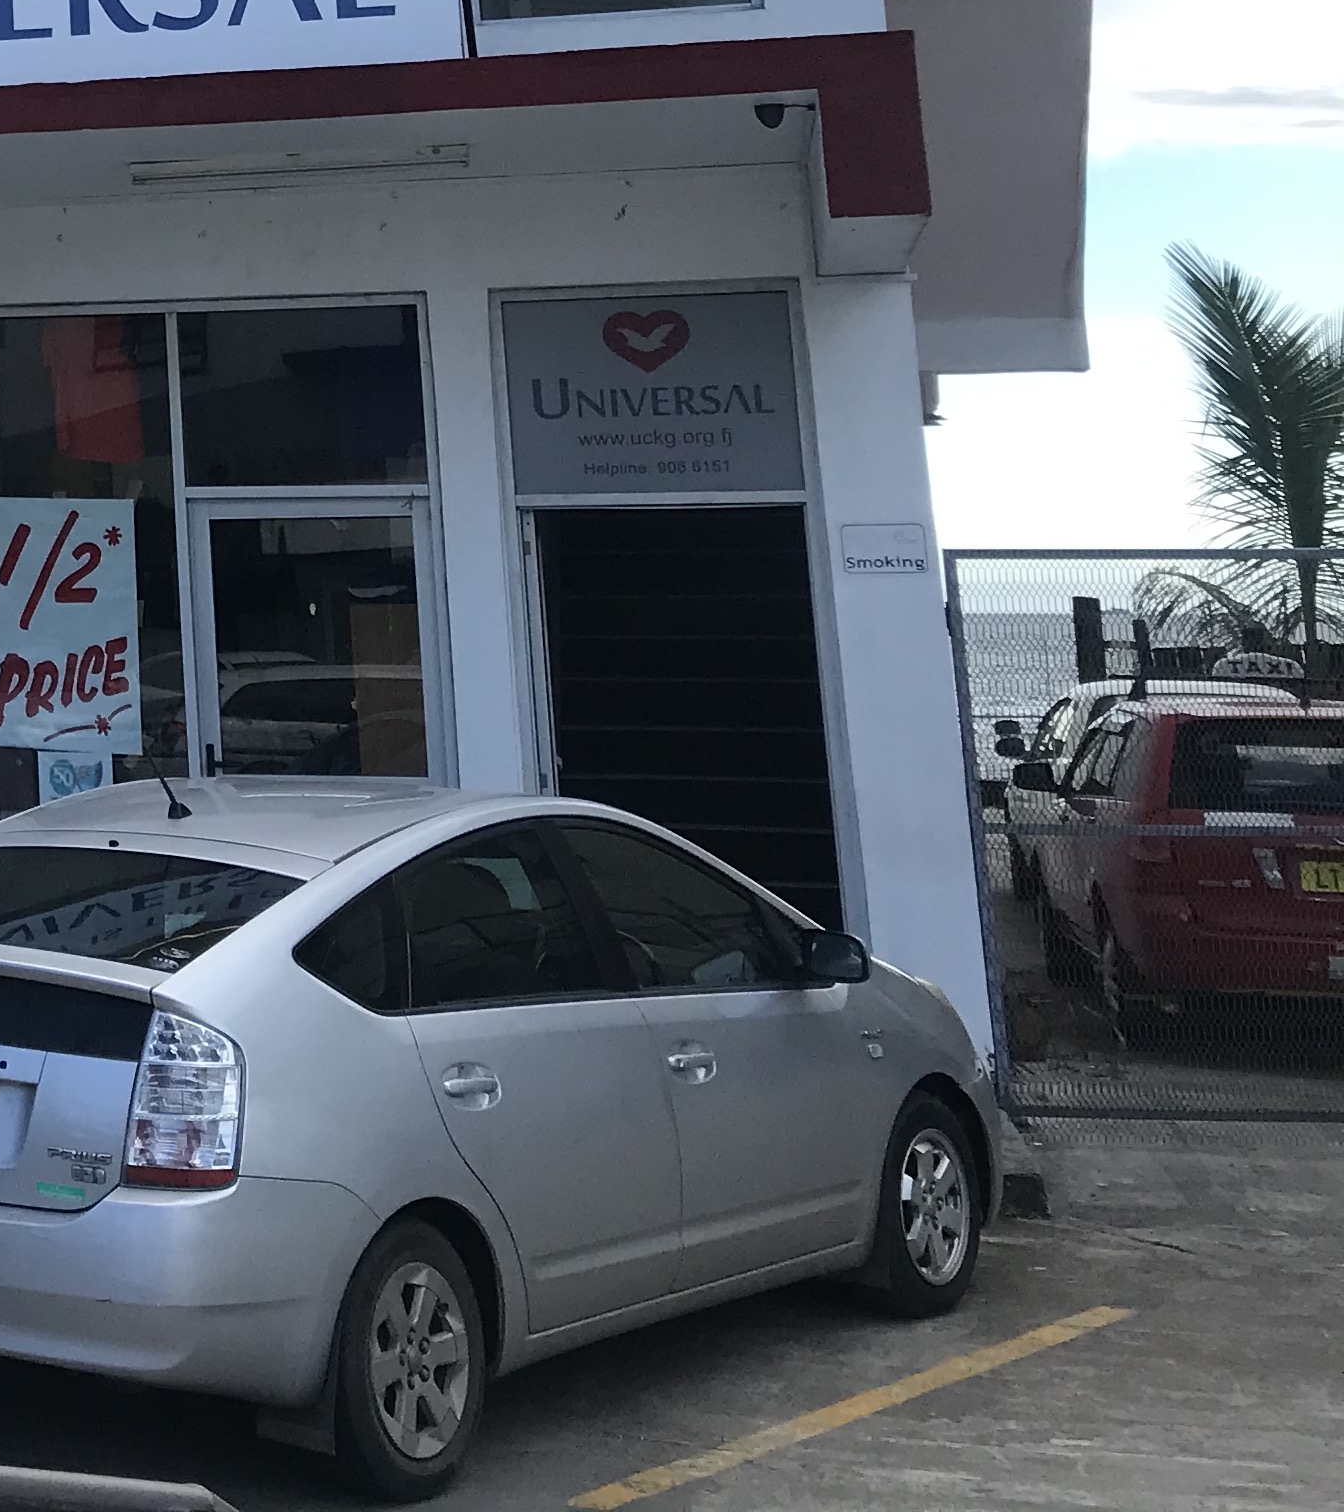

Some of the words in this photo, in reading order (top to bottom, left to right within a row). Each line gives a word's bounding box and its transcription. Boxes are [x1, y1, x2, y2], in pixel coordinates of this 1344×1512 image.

[531, 377, 776, 420] UNIVERSAL
[846, 555, 926, 571] Smoking
[1227, 660, 1293, 675] TAXI
